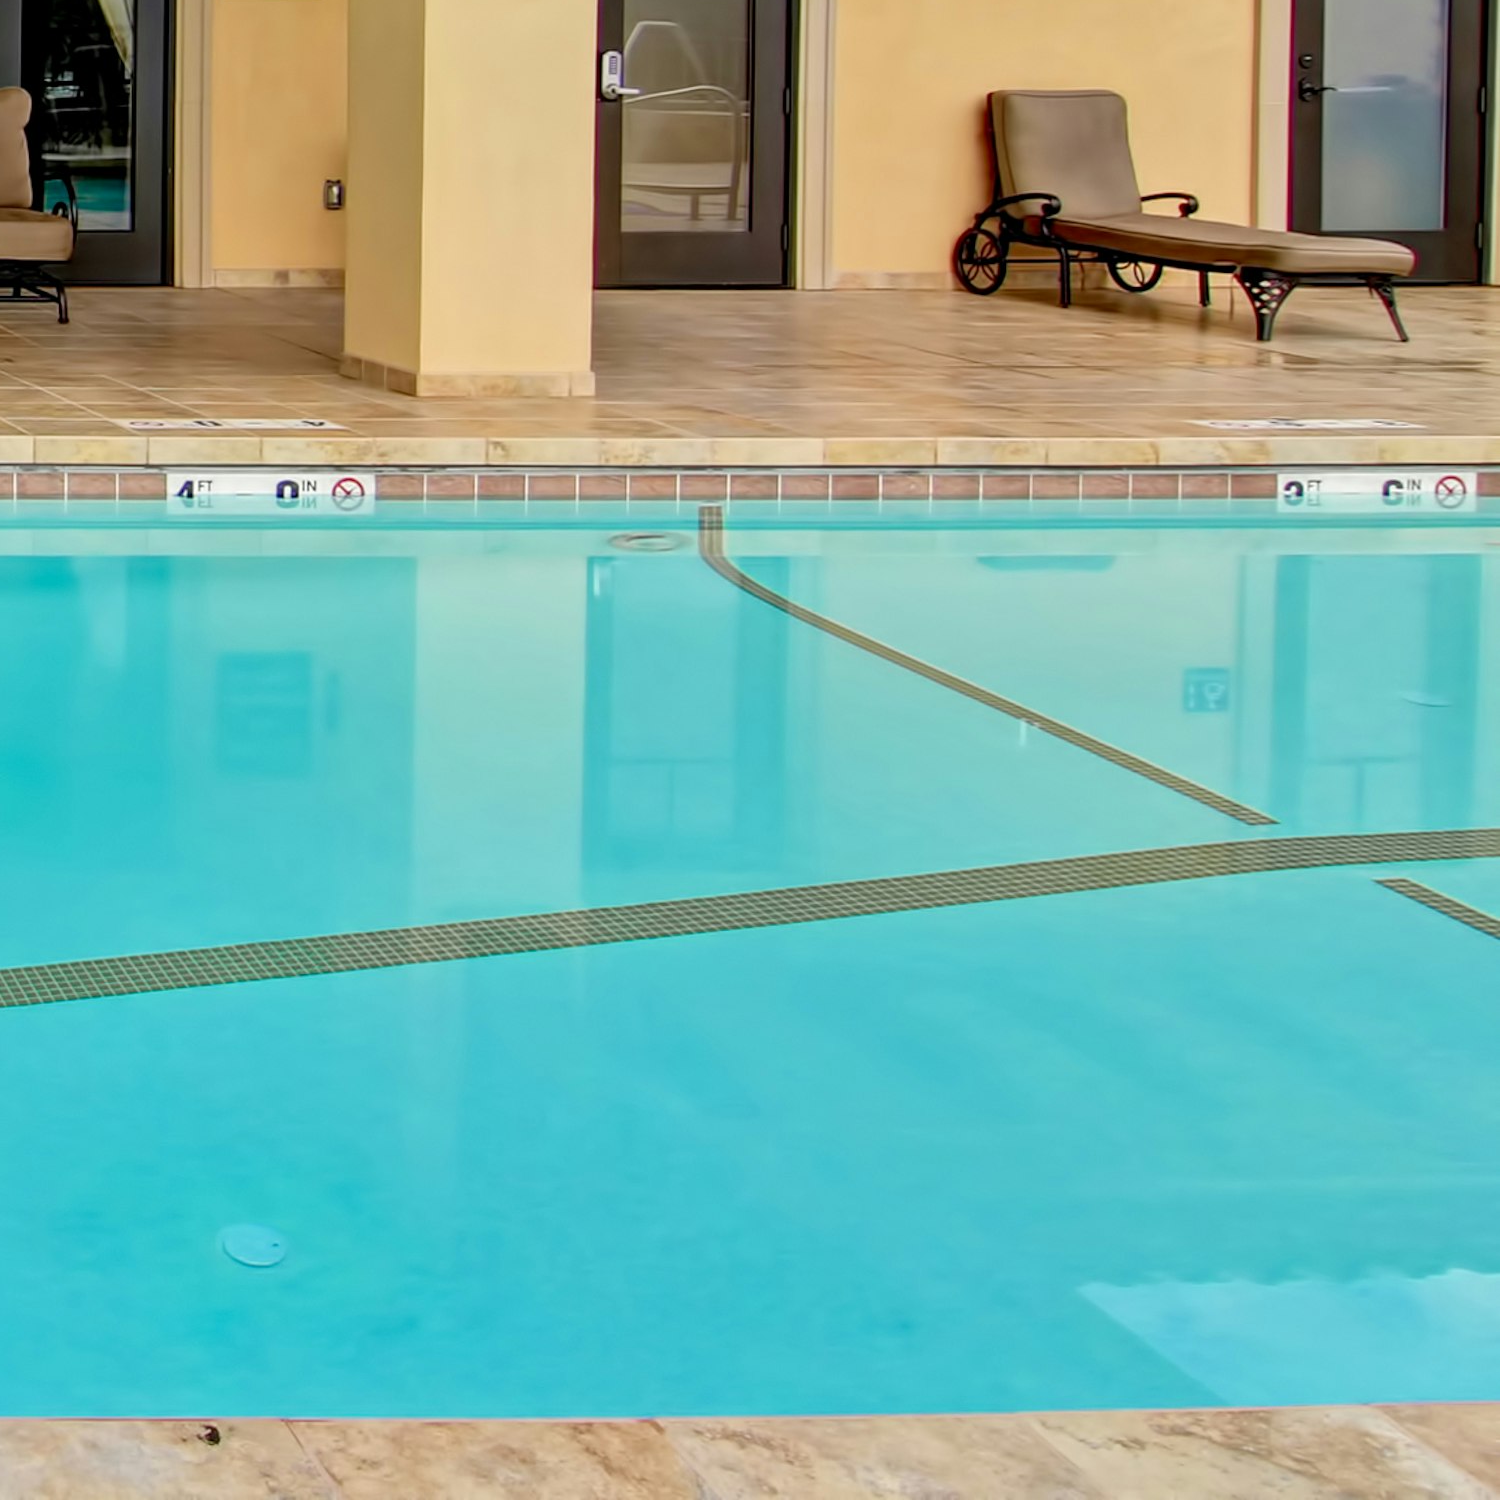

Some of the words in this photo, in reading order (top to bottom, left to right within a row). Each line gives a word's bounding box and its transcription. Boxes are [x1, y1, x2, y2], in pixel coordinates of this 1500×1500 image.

[198, 480, 213, 492] FT
[302, 480, 317, 492] IN
[1307, 480, 1322, 492] FT
[1407, 479, 1422, 492] IN
